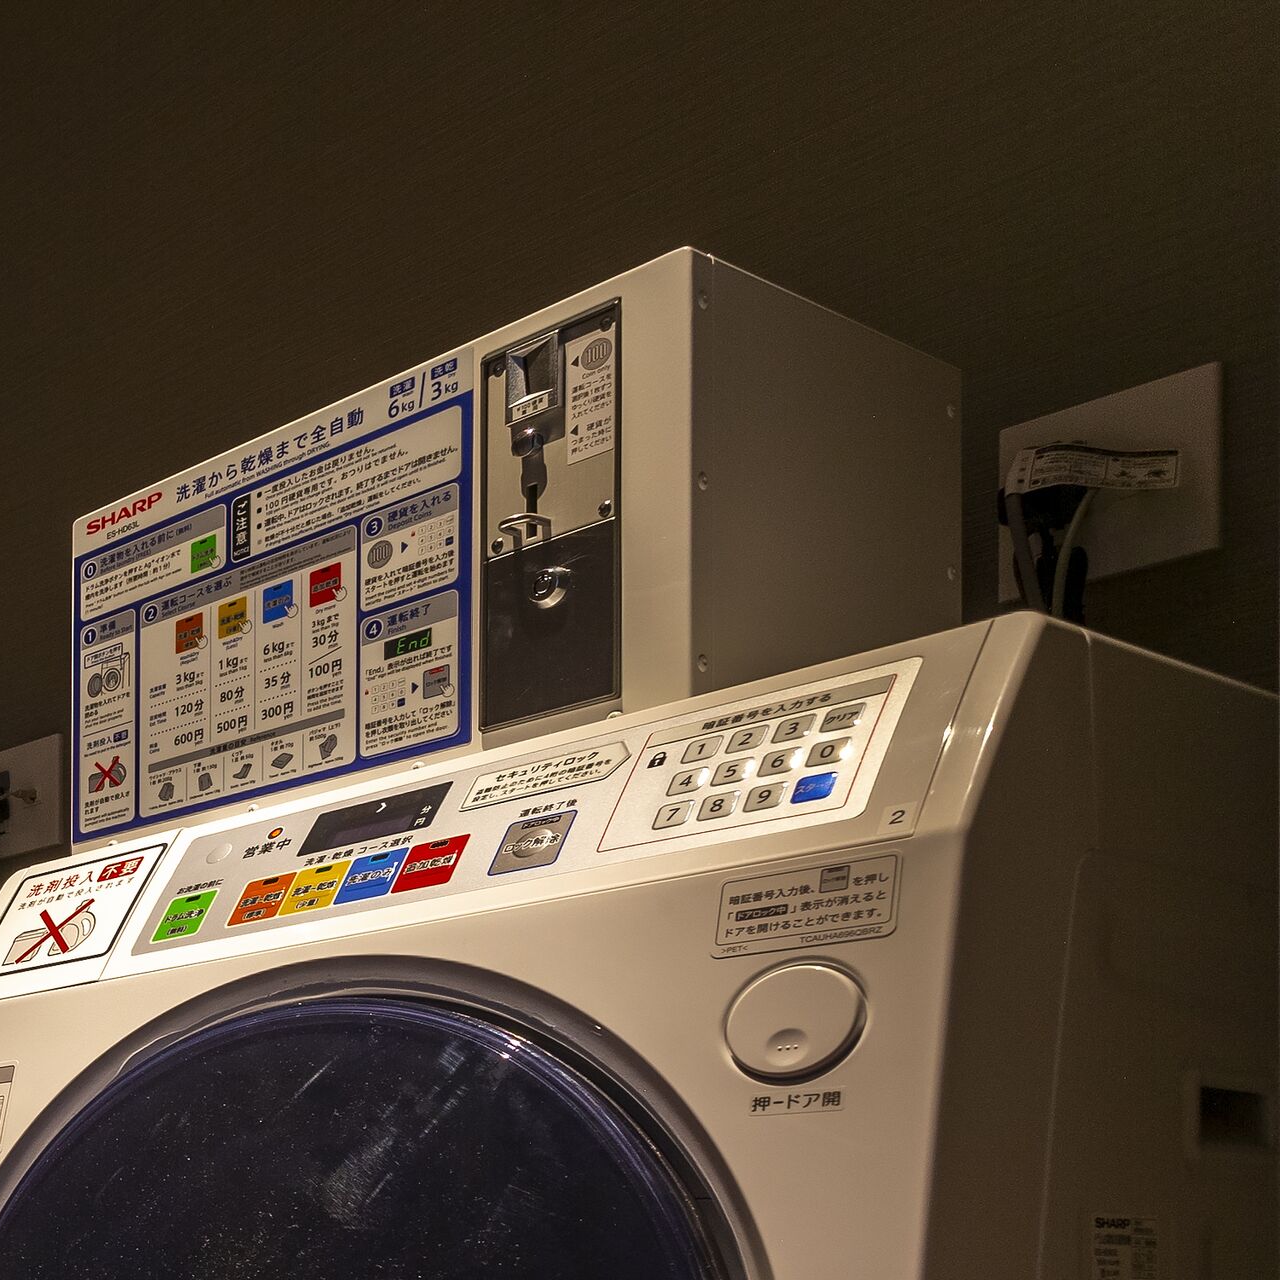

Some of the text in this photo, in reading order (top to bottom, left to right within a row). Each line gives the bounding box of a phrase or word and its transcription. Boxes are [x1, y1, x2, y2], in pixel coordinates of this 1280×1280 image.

[582, 365, 611, 380] Coin only
[572, 374, 612, 395] 運転コースを
[571, 392, 612, 411] ゆっくり硬貨を
[571, 401, 612, 420] 入れてください
[586, 416, 611, 431] 硬貨が
[571, 427, 612, 446] つまった時に
[571, 437, 612, 455] 押してください
[177, 405, 363, 503] 洗濯から乾燥まで全自動
[257, 460, 281, 477] WASHING
[265, 443, 374, 495] 一度投入したお金は戻りません。
[87, 490, 161, 535] SHARP
[388, 489, 451, 523] 硬貨を入れる
[107, 520, 138, 539] ES-HD63L
[237, 501, 247, 545] ご注意
[100, 529, 172, 567] 洗濯物を入れる前に
[365, 549, 453, 585] 硬貨を入れて暗証番号を入力後
[365, 558, 453, 594] スタートを押すと運転を始めます
[161, 575, 230, 610] 運転コースを選ぶ
[388, 603, 429, 626] 運転終了
[312, 629, 338, 648] 30分
[397, 630, 429, 654] End
[309, 658, 341, 679] 100円
[265, 671, 290, 689] 35分
[220, 685, 243, 703] 80分
[175, 698, 203, 717] 120分
[261, 701, 292, 721] 300円
[702, 692, 831, 730] 暗証番号を入力する
[217, 715, 246, 734] 500円
[825, 711, 858, 725] クリア
[175, 728, 202, 746] 600円
[787, 722, 798, 736] 3
[742, 732, 752, 746] 2
[820, 745, 834, 758] 0
[496, 752, 599, 782] セキュリティロック
[725, 765, 736, 778] 5
[771, 756, 784, 768] 6
[472, 770, 601, 802] 設定し、スタートを押してください。
[475, 759, 612, 795] 盗難防止のために4桁の暗証番号を
[679, 774, 692, 788] 4
[709, 799, 722, 812] 8
[758, 789, 771, 803] 9
[421, 805, 432, 814] 分
[519, 799, 577, 817] 運転終了後
[665, 808, 678, 822] 7
[890, 810, 905, 825] 2
[414, 818, 426, 826] 円
[242, 838, 292, 859] 営業中
[357, 835, 414, 854] コース選択
[505, 834, 560, 852] ロック解除
[26, 860, 141, 899] 洗剤投入 不要
[853, 873, 889, 886] を押し
[18, 876, 134, 911] 洗剤が自動で投入されます
[729, 884, 814, 906] 暗証番号入力後、
[164, 908, 204, 923] ドラム洗浄
[725, 909, 882, 938] ドアを開けることができます。
[1095, 1218, 1130, 1228] SHARP
